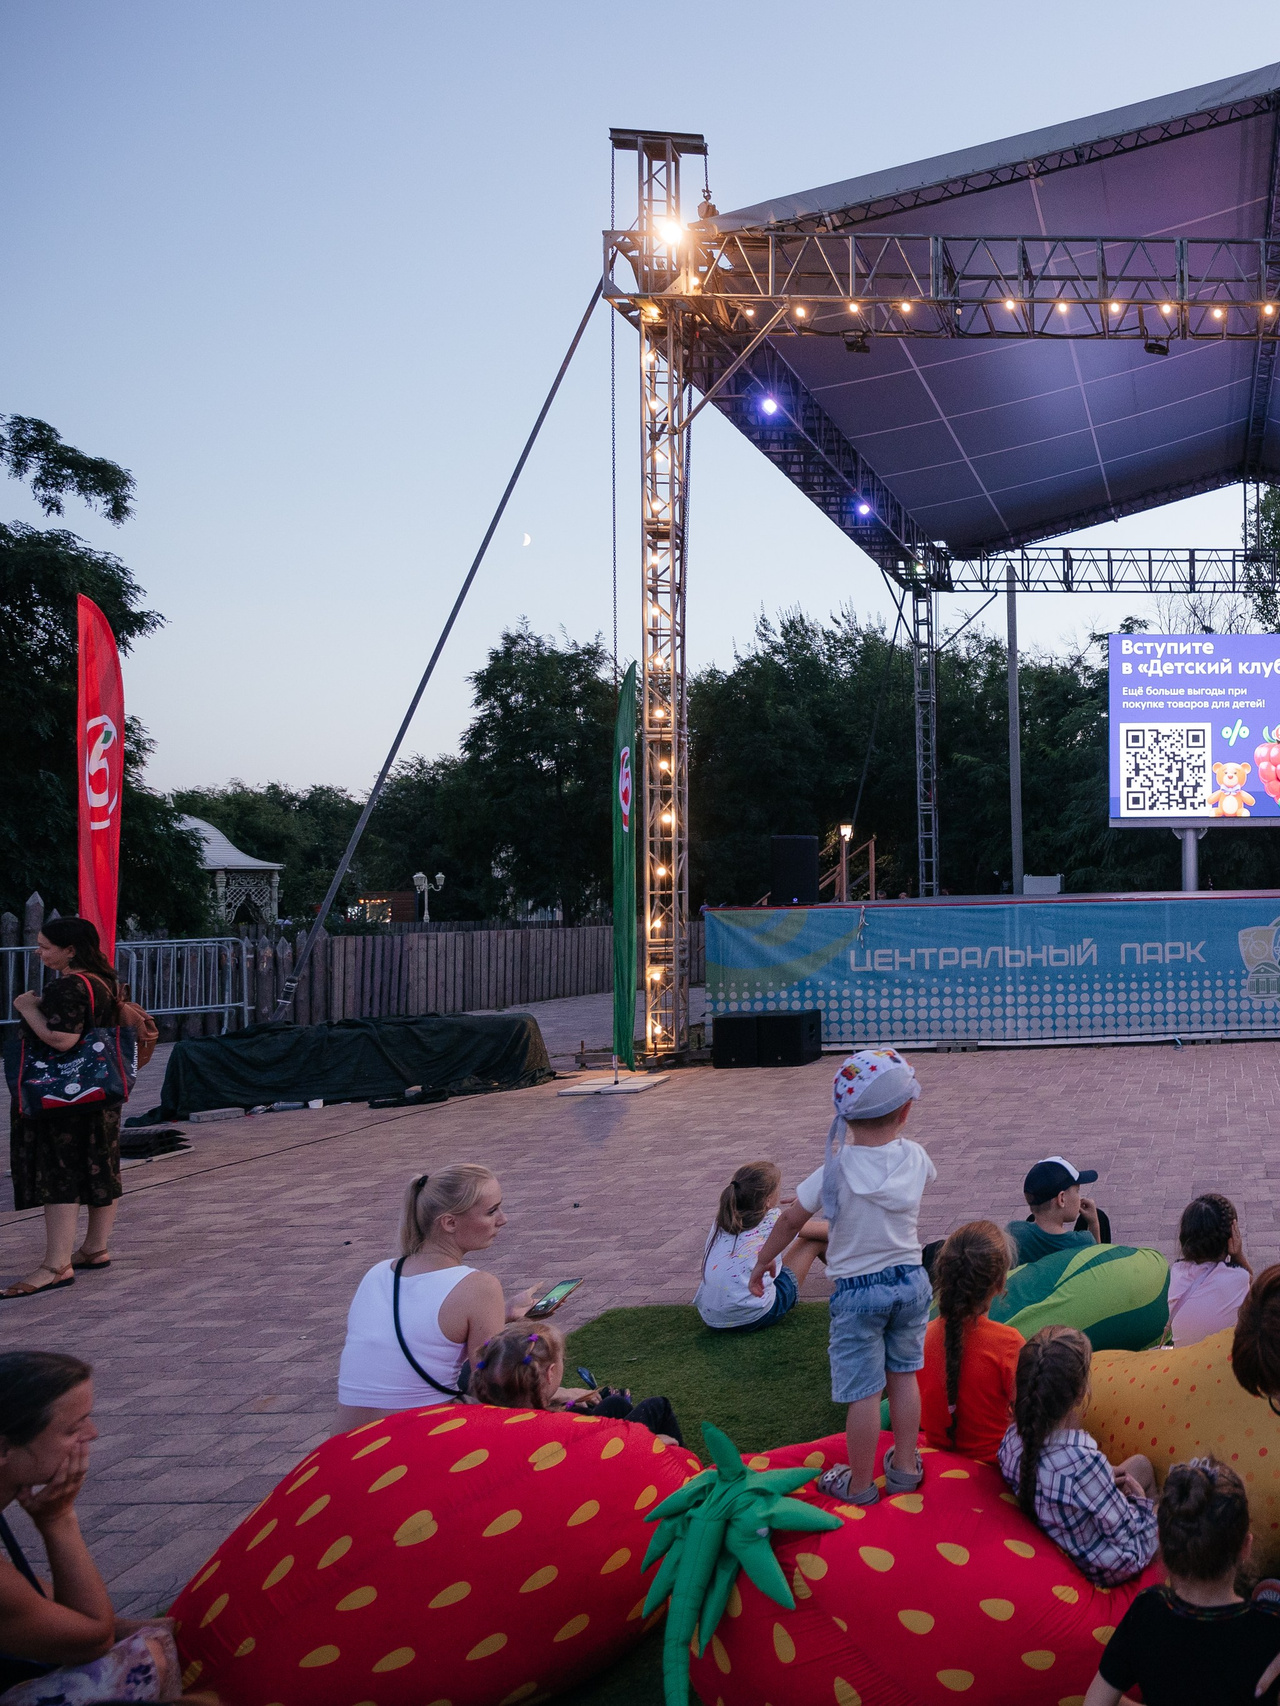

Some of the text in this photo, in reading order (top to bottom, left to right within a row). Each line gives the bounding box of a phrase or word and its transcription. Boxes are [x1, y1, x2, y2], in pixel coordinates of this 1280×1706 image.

[1121, 639, 1214, 658] Вступите
[1121, 662, 1133, 675] в
[1137, 658, 1232, 677] «Детский
[1122, 686, 1248, 697] Ещё больше выгоды при
[1122, 699, 1266, 710] покупке товаров для детей!
[850, 938, 1098, 971] ЦЕНТРАЛЬНЫЙ
[1120, 940, 1206, 965] ПАРК
